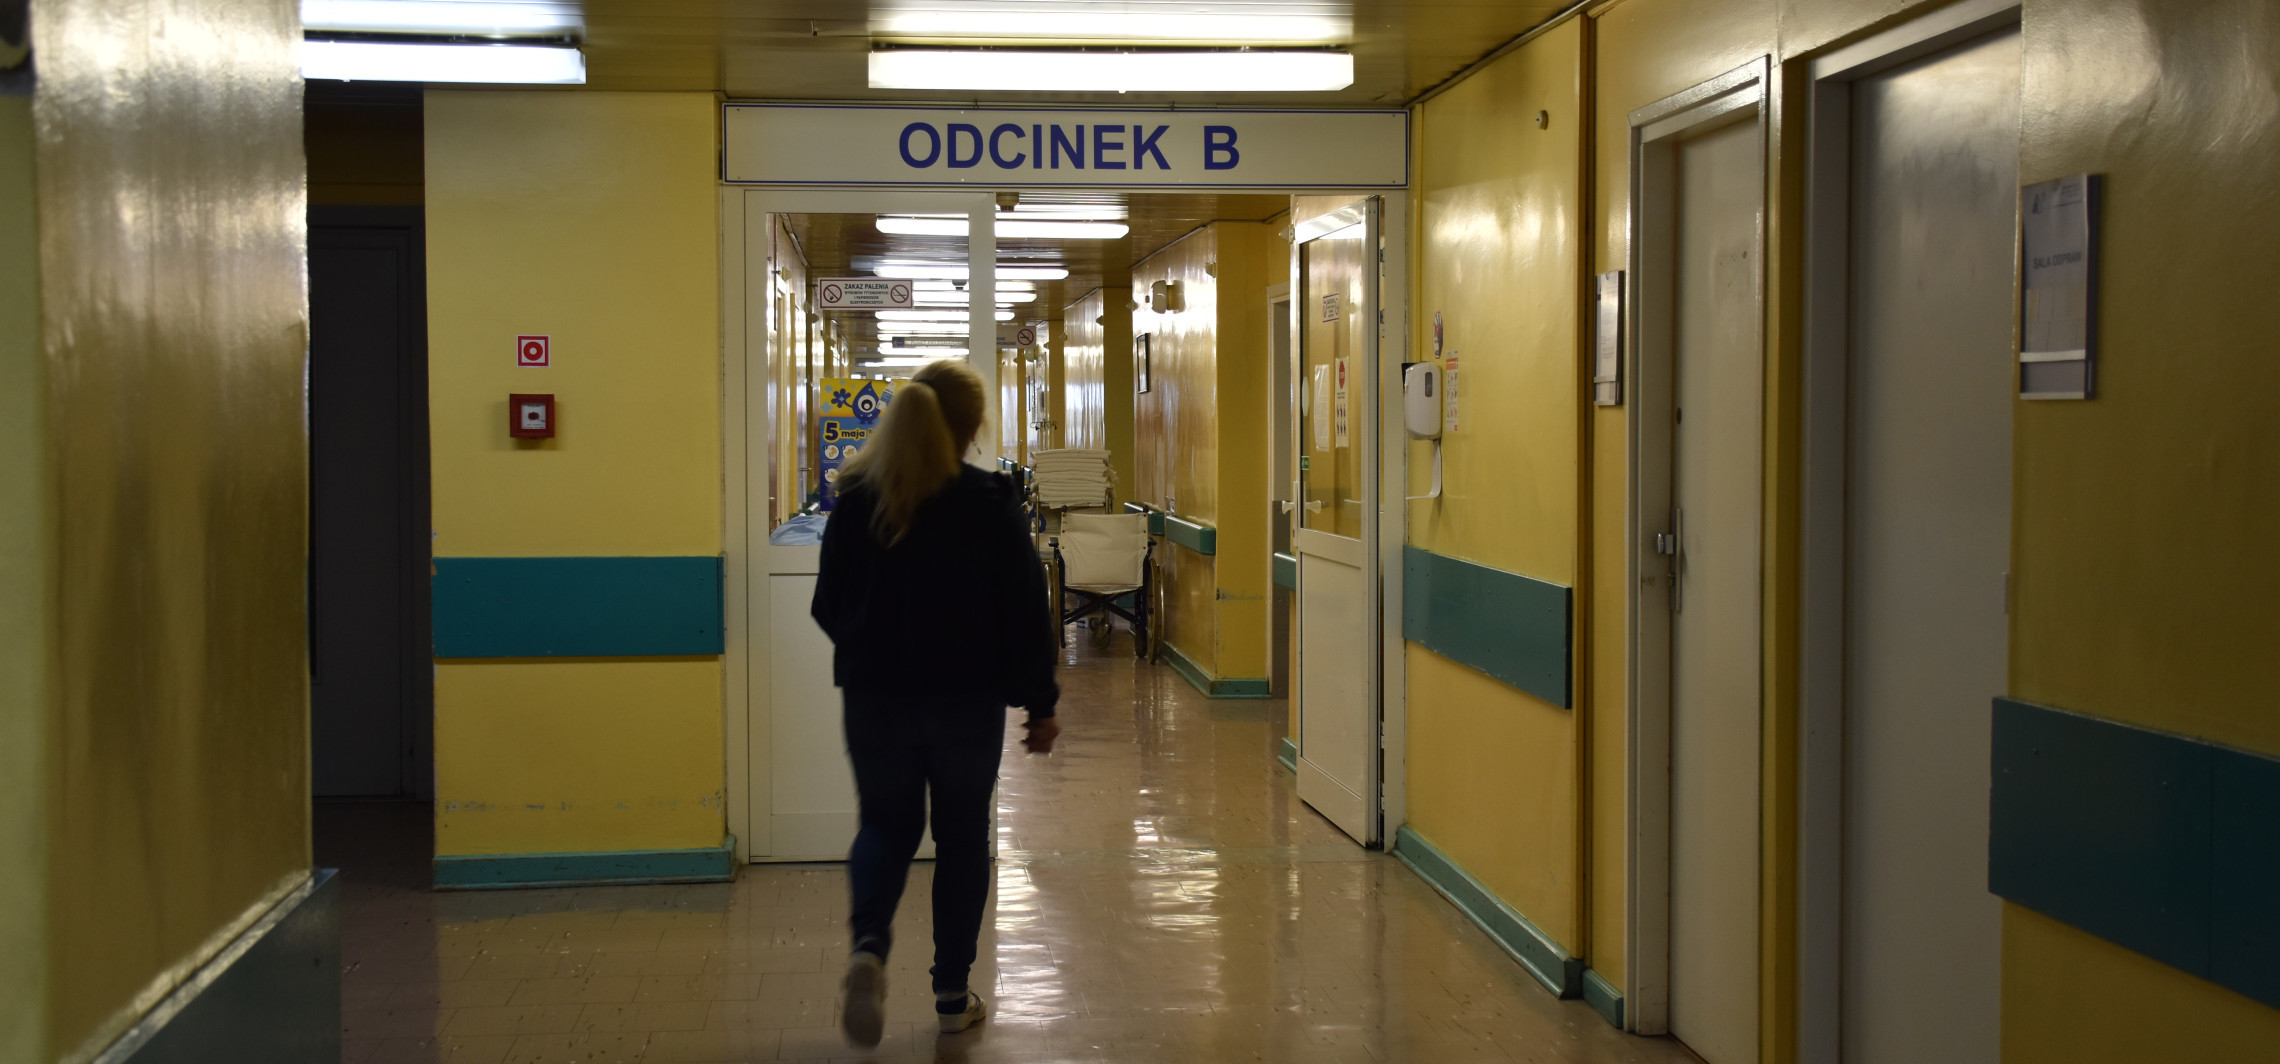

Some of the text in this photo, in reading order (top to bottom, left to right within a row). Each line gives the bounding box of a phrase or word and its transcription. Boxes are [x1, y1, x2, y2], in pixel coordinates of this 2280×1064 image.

[899, 122, 1240, 170] ODCINEK B
[2032, 256, 2051, 270] SALA
[825, 422, 839, 441] 5
[841, 430, 865, 439] maja
